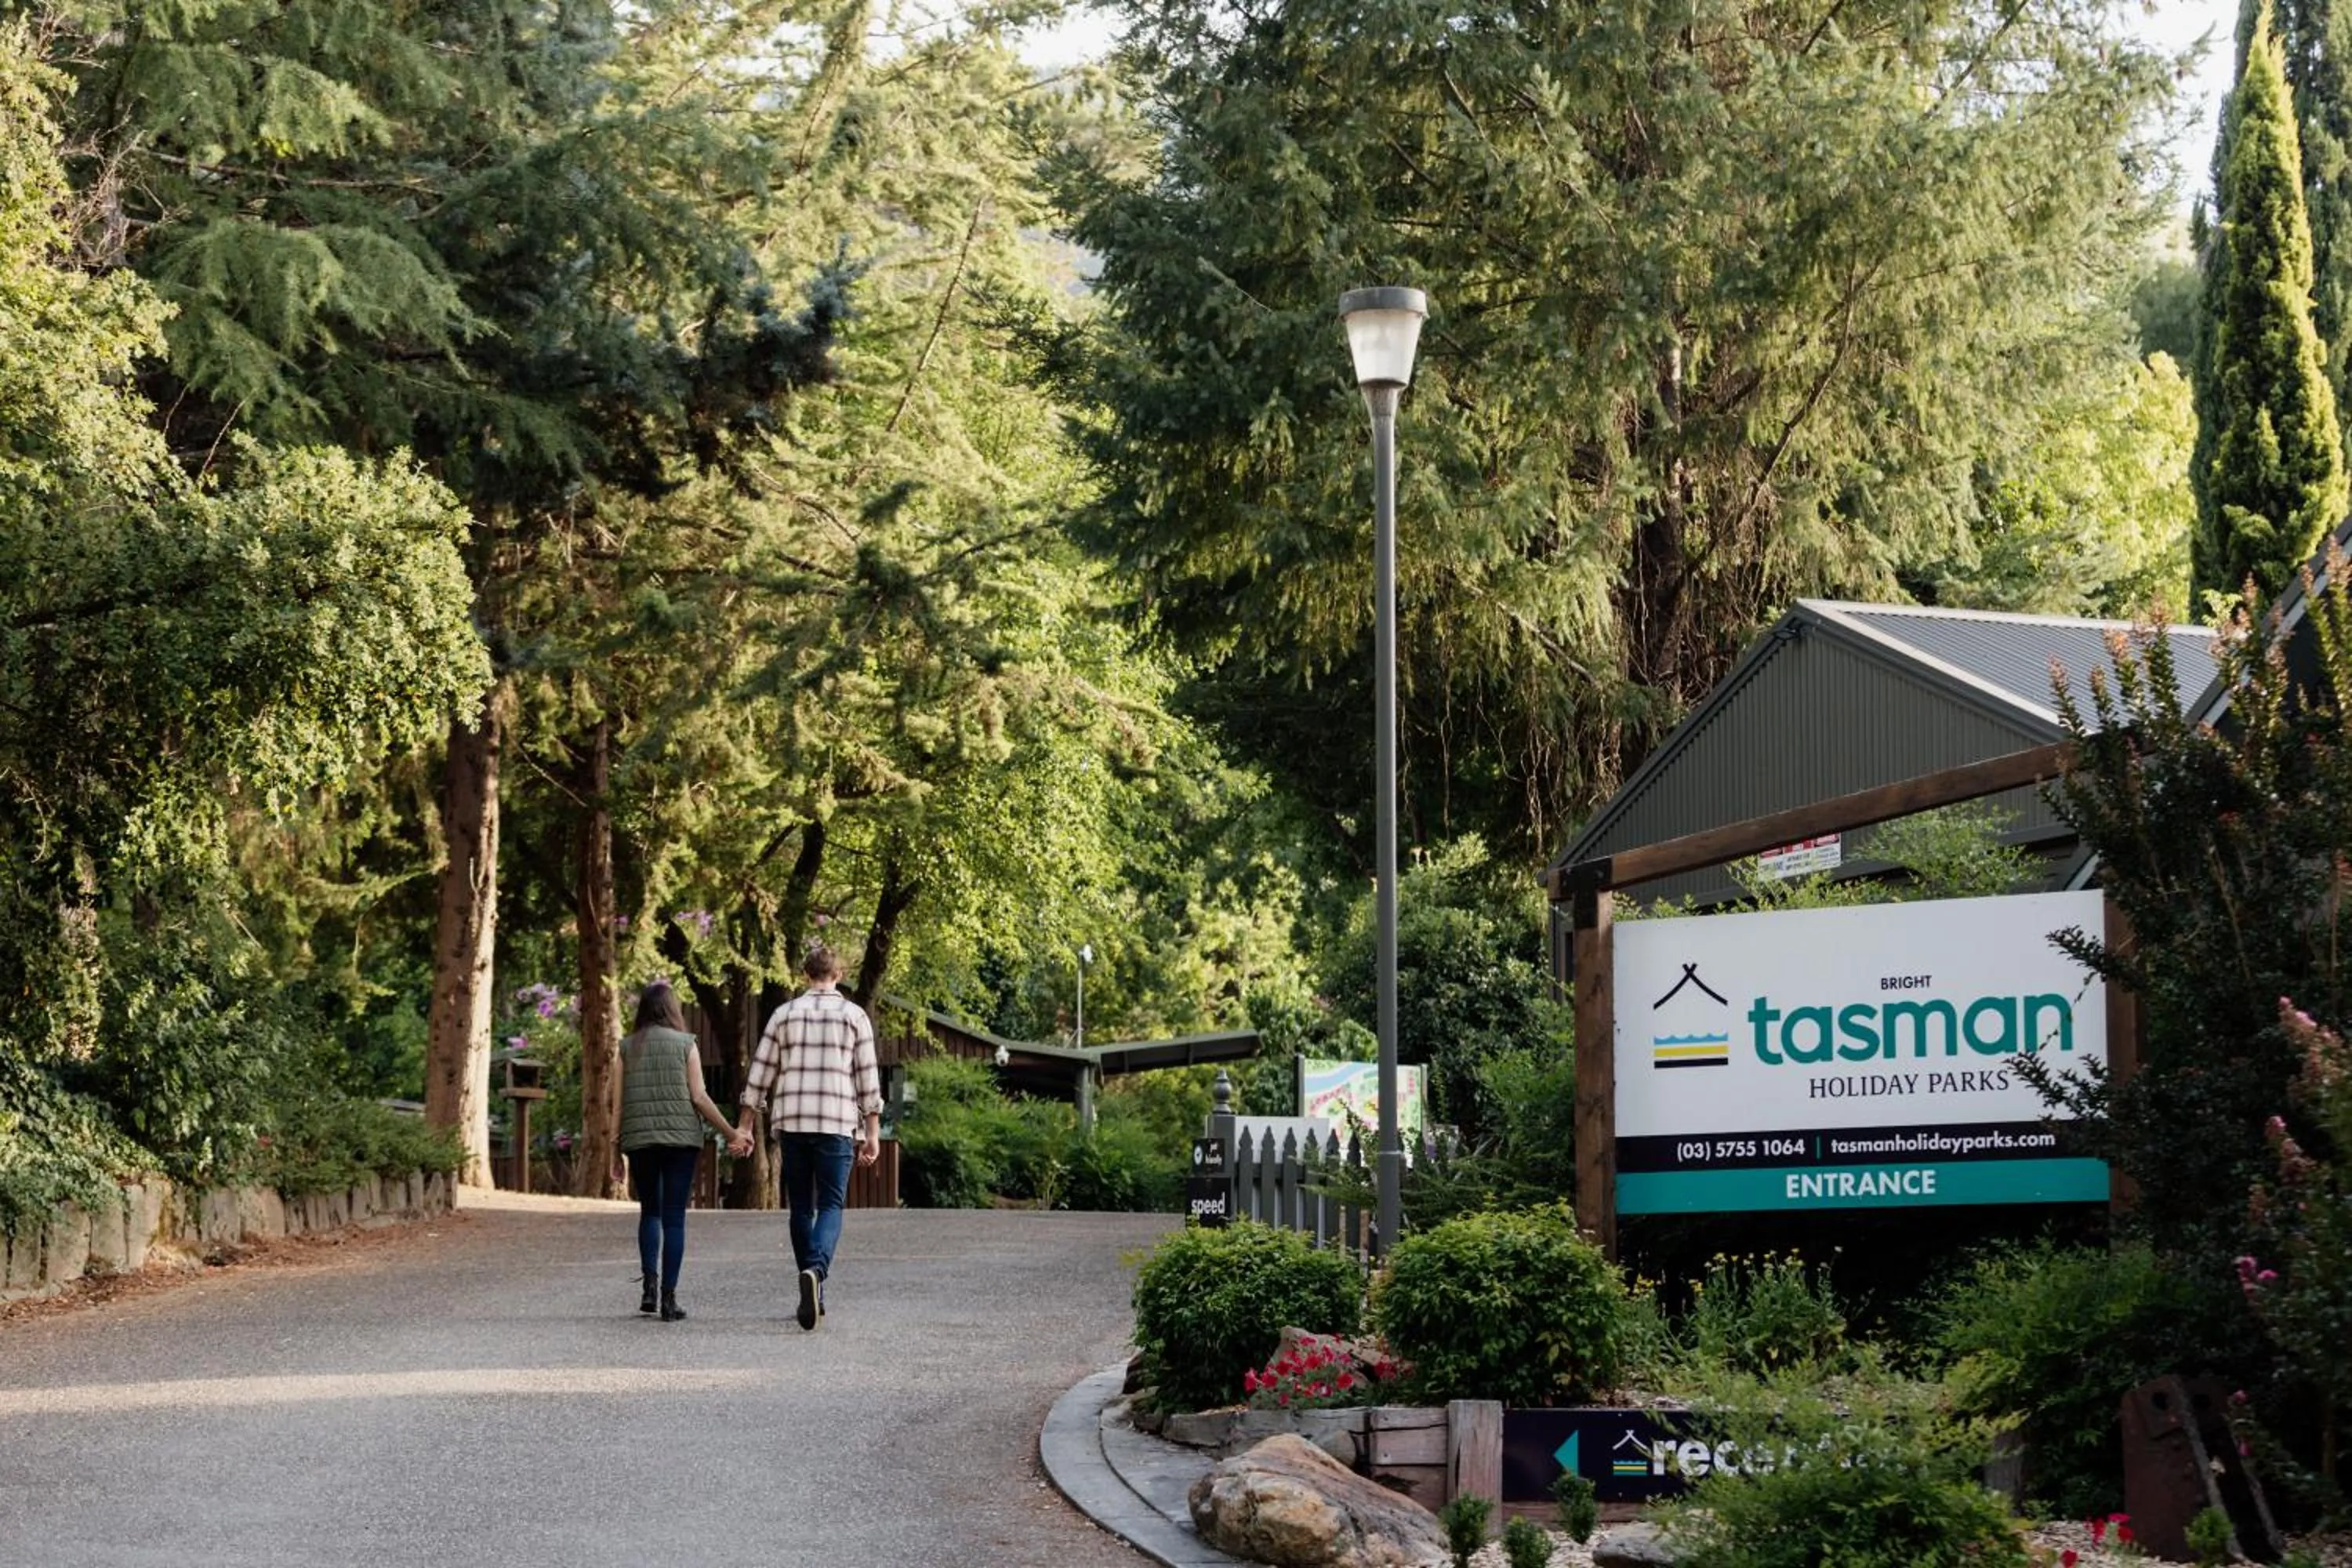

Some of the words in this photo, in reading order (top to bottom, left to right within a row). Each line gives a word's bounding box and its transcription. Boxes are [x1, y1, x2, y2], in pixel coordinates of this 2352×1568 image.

[1880, 975, 1933, 990] BRIGHT
[1748, 993, 2074, 1065] tasman
[1809, 1073, 1920, 1098] HOLIDAY
[1927, 1069, 2009, 1094] PARKS
[1676, 1142, 1711, 1163] (03)
[1715, 1140, 1757, 1158] 5755
[1762, 1138, 1806, 1156] 1064
[1831, 1131, 2056, 1154] tasmanholidayparks.com
[1785, 1169, 1937, 1199] ENTRANCE
[1192, 1191, 1225, 1220] speed
